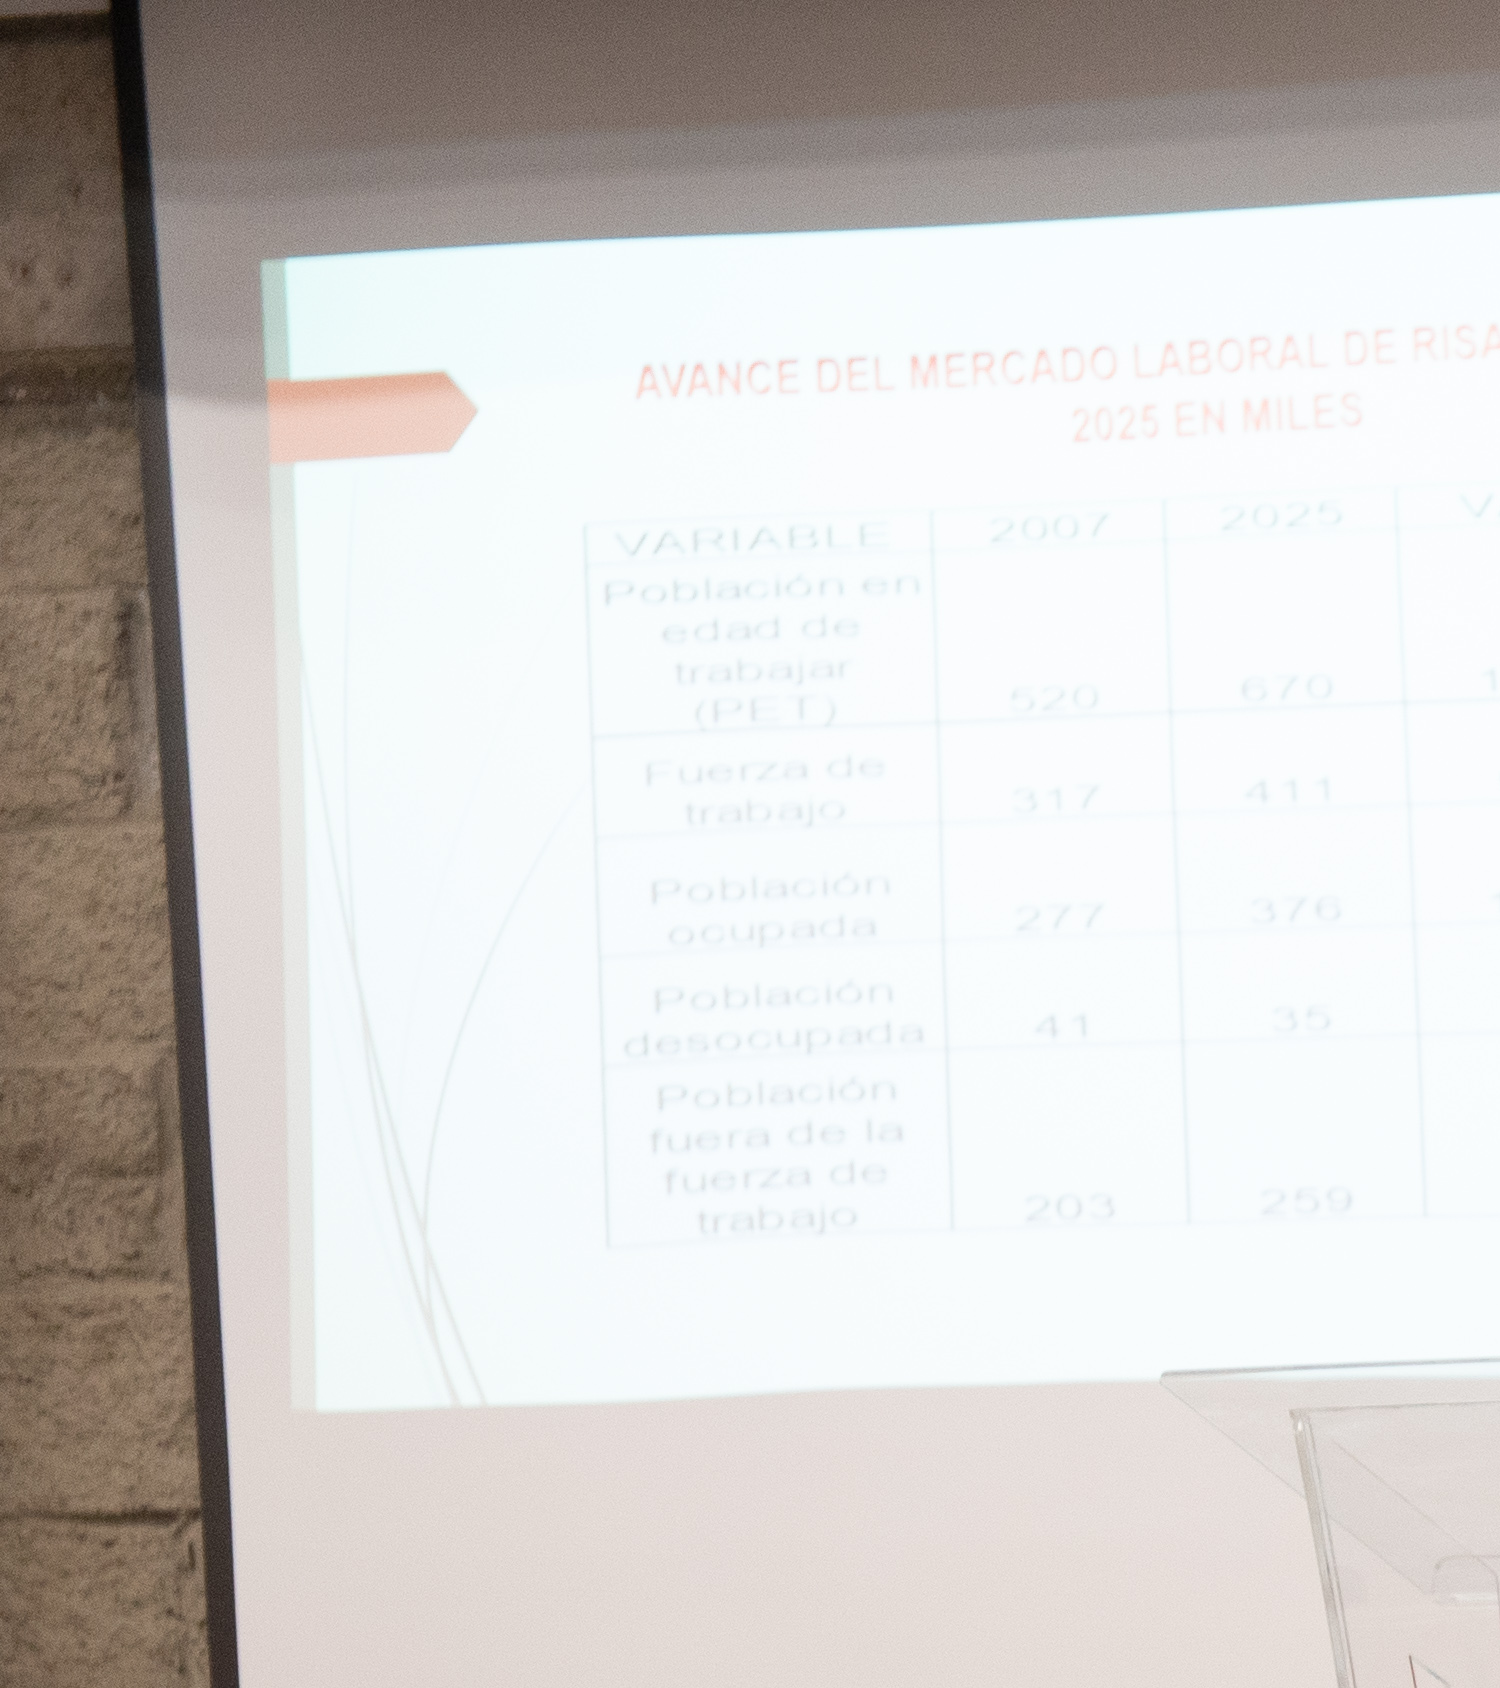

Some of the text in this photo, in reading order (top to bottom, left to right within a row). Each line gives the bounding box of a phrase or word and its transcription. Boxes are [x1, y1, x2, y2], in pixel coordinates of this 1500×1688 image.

[635, 357, 799, 398] AVANCE
[817, 355, 895, 394] DEL
[910, 344, 1118, 389] MERCADO
[1133, 332, 1328, 379] LABORAL
[1344, 328, 1396, 367] DE
[1072, 392, 1364, 443] 2025 EN MILES
[986, 511, 1112, 546] 2007
[1220, 500, 1345, 533] 2025
[615, 520, 892, 558] VARIABLE
[603, 572, 922, 608] Población en
[661, 613, 862, 645] edad de
[675, 654, 850, 687] trabajar
[1009, 683, 1101, 715] 520
[1239, 674, 1335, 702] 670
[694, 695, 839, 731] (PET)
[645, 754, 887, 789] Fuerza de
[1012, 783, 1102, 815] 317
[1243, 775, 1333, 805] 411
[686, 797, 847, 829] trabajo
[650, 871, 892, 907] Población
[1015, 901, 1106, 934] 277
[1251, 896, 1343, 926] 376
[668, 912, 878, 949] ocupada
[653, 979, 895, 1015] Población
[1033, 1012, 1090, 1041] 41
[1272, 1005, 1334, 1033] 35
[623, 1020, 925, 1060] desocupada
[657, 1075, 898, 1112] Población
[649, 1117, 906, 1156] fuera de la
[664, 1158, 888, 1195] fuerza de
[1025, 1193, 1117, 1224] 203
[1260, 1185, 1354, 1219] 259
[697, 1204, 859, 1236] trabajo
